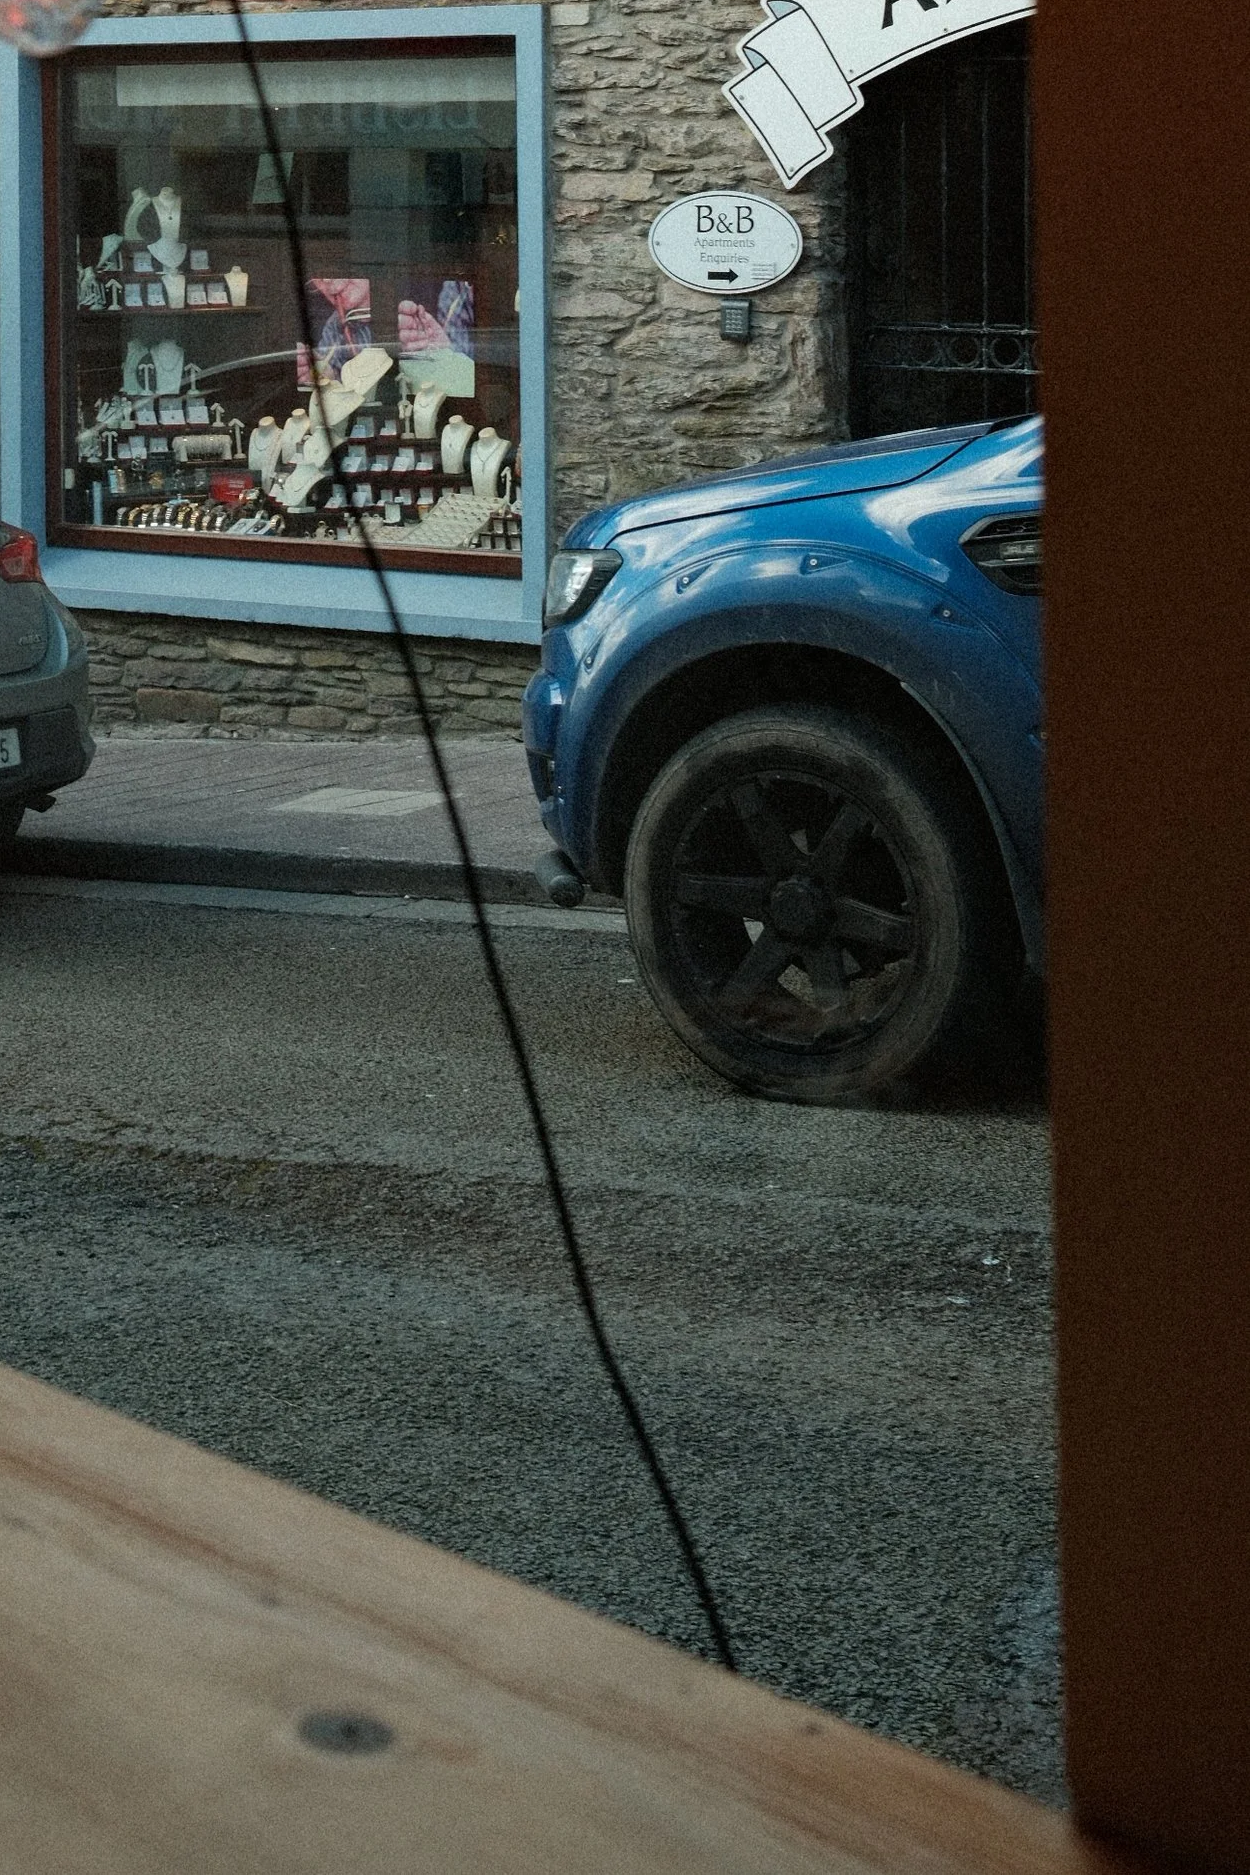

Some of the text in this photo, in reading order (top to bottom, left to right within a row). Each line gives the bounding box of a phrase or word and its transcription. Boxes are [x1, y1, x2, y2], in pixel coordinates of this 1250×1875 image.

[694, 205, 755, 234] B&B
[694, 237, 755, 249] Apartments
[700, 252, 749, 265] Enquiries
